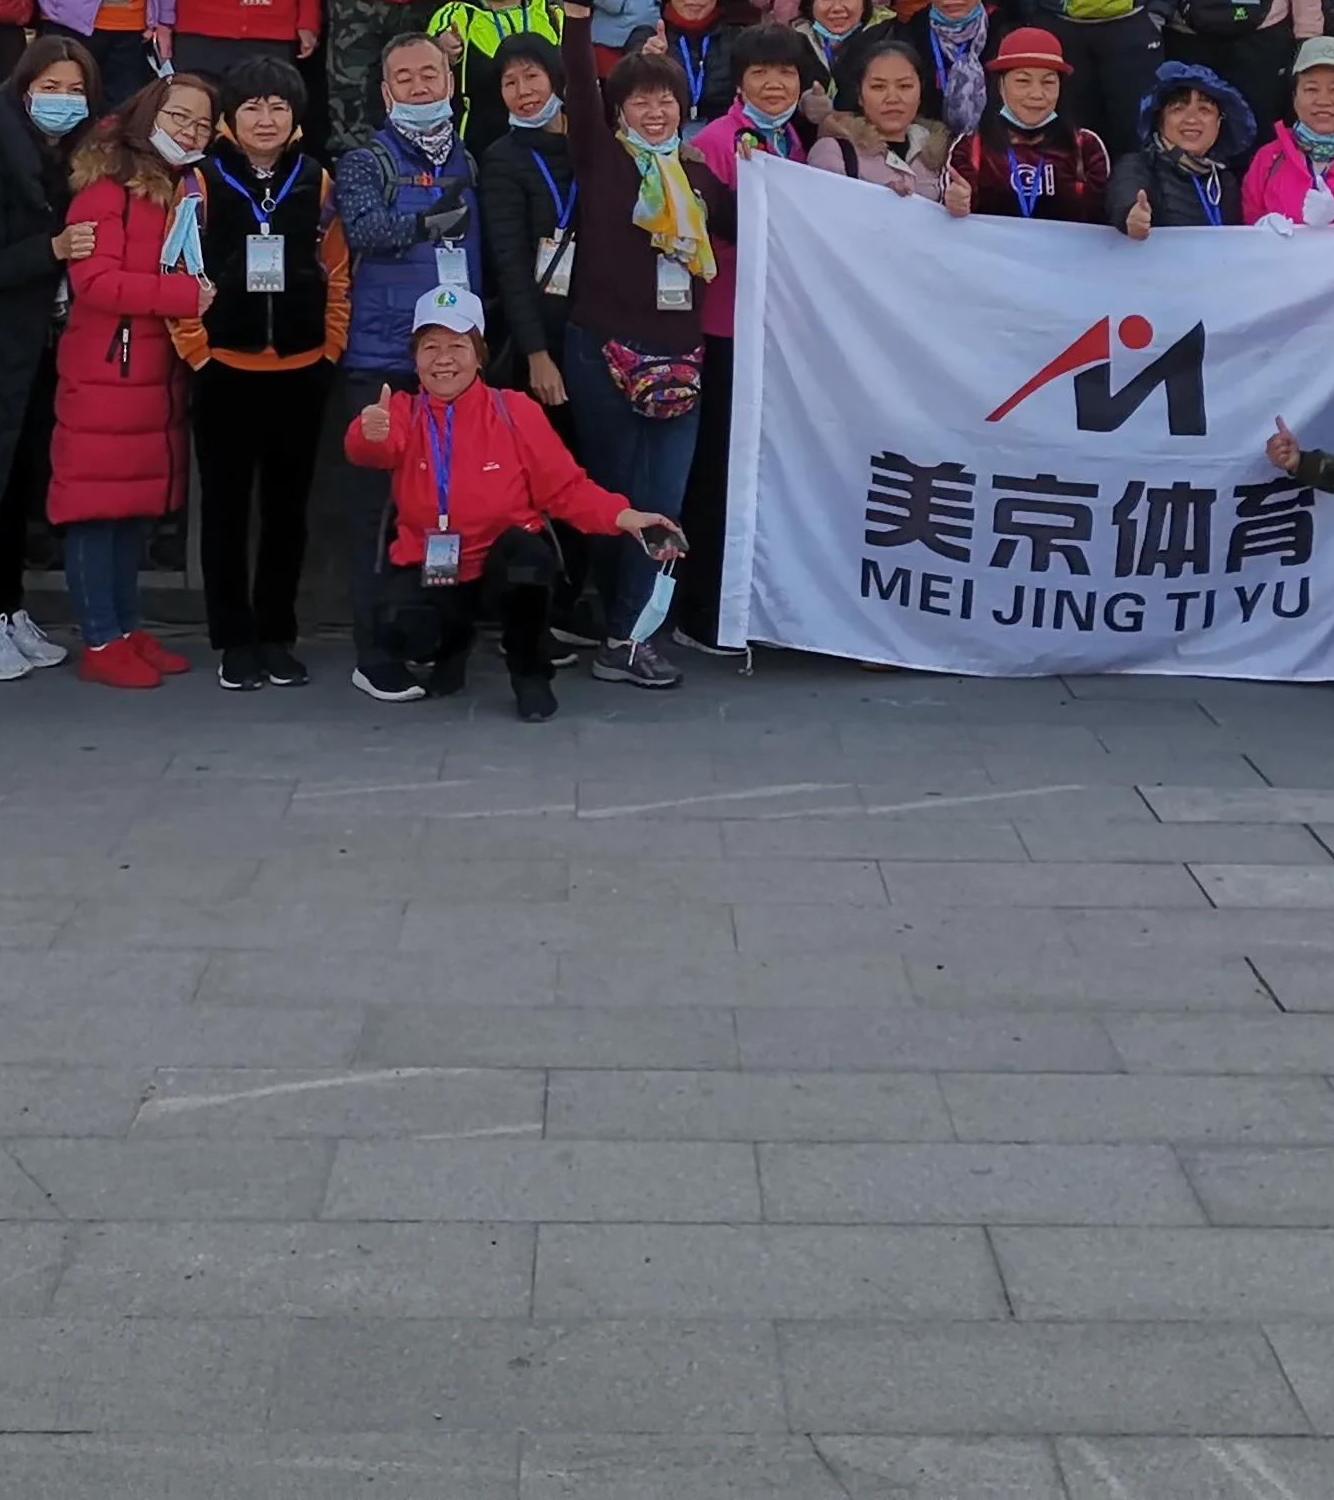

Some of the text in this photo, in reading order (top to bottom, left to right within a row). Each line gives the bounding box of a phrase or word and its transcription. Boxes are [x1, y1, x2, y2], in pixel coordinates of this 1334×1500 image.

[865, 451, 1314, 579] 美京体育
[860, 558, 972, 620] MEI
[992, 585, 1145, 634] JING
